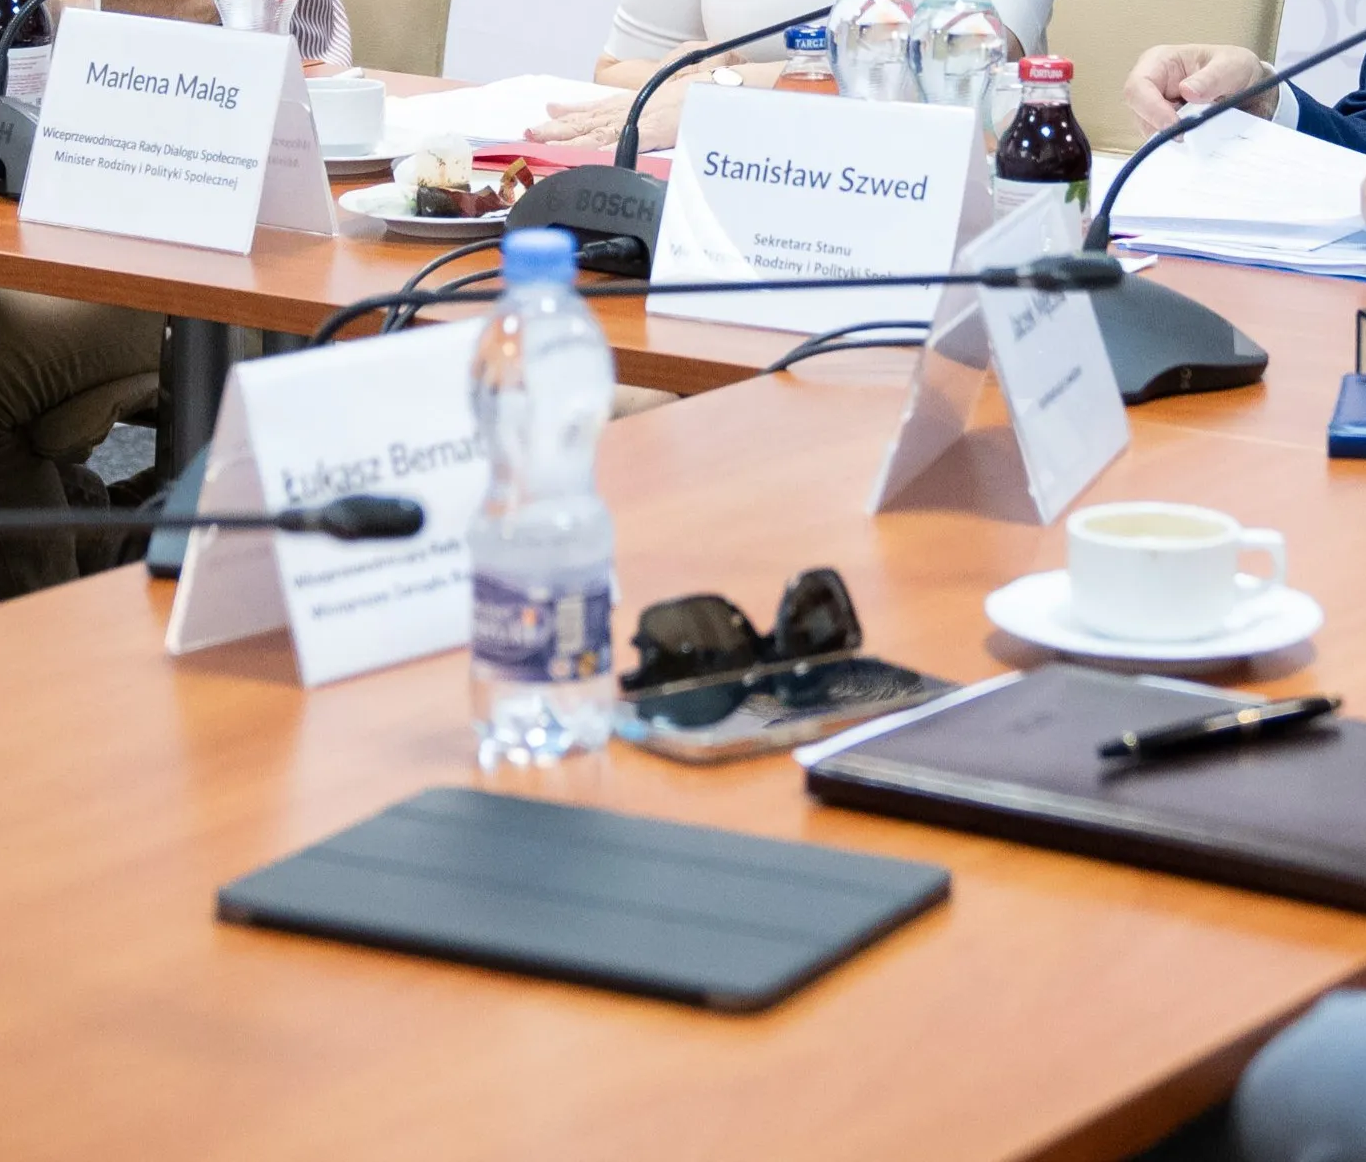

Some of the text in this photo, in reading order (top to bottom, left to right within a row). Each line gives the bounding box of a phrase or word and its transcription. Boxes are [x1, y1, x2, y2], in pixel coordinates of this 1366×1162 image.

[794, 38, 825, 48] TARCZ
[86, 62, 170, 95] Marlena
[175, 73, 240, 110] Maląg
[1029, 67, 1064, 79] FORTUNA
[42, 126, 137, 152] Wiceprzewodnicząca
[139, 140, 162, 156] Rady
[164, 144, 199, 161] Dialogu
[201, 151, 259, 170] Społecznego
[54, 150, 96, 168] Minister
[98, 157, 137, 175] Rodziny
[145, 164, 183, 182] Polityki
[185, 170, 239, 191] Społecznej
[703, 151, 929, 202] Stanisław Szwed
[575, 188, 655, 222] BOSCH
[753, 233, 851, 257] Sekretarz Stanu
[753, 254, 804, 274] Rodziny
[814, 262, 862, 280] Polityki
